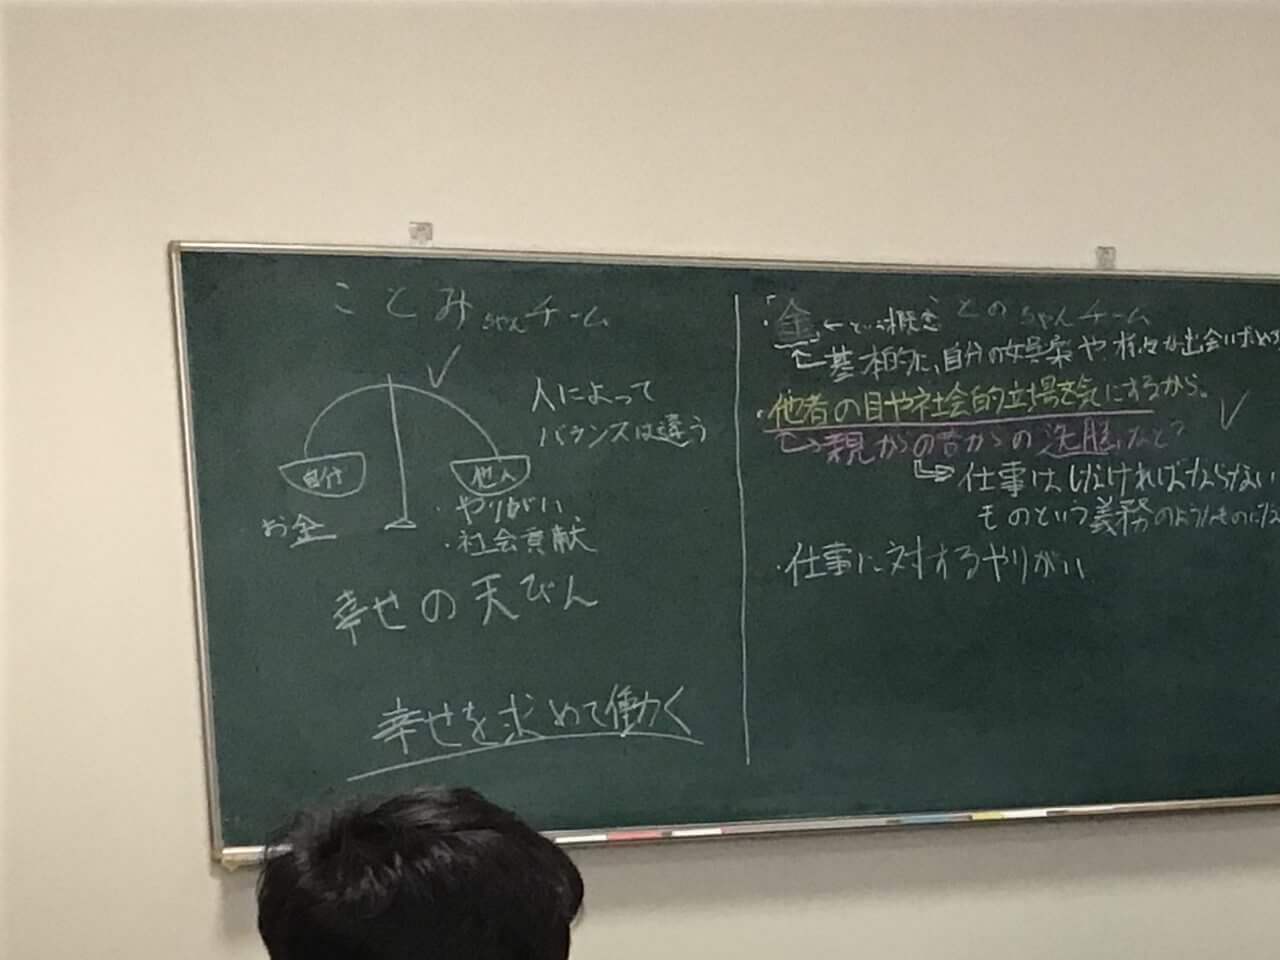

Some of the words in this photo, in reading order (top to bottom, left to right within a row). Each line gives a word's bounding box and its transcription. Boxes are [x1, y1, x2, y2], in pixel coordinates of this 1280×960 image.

[371, 684, 692, 755] 幸せを求めて働く
